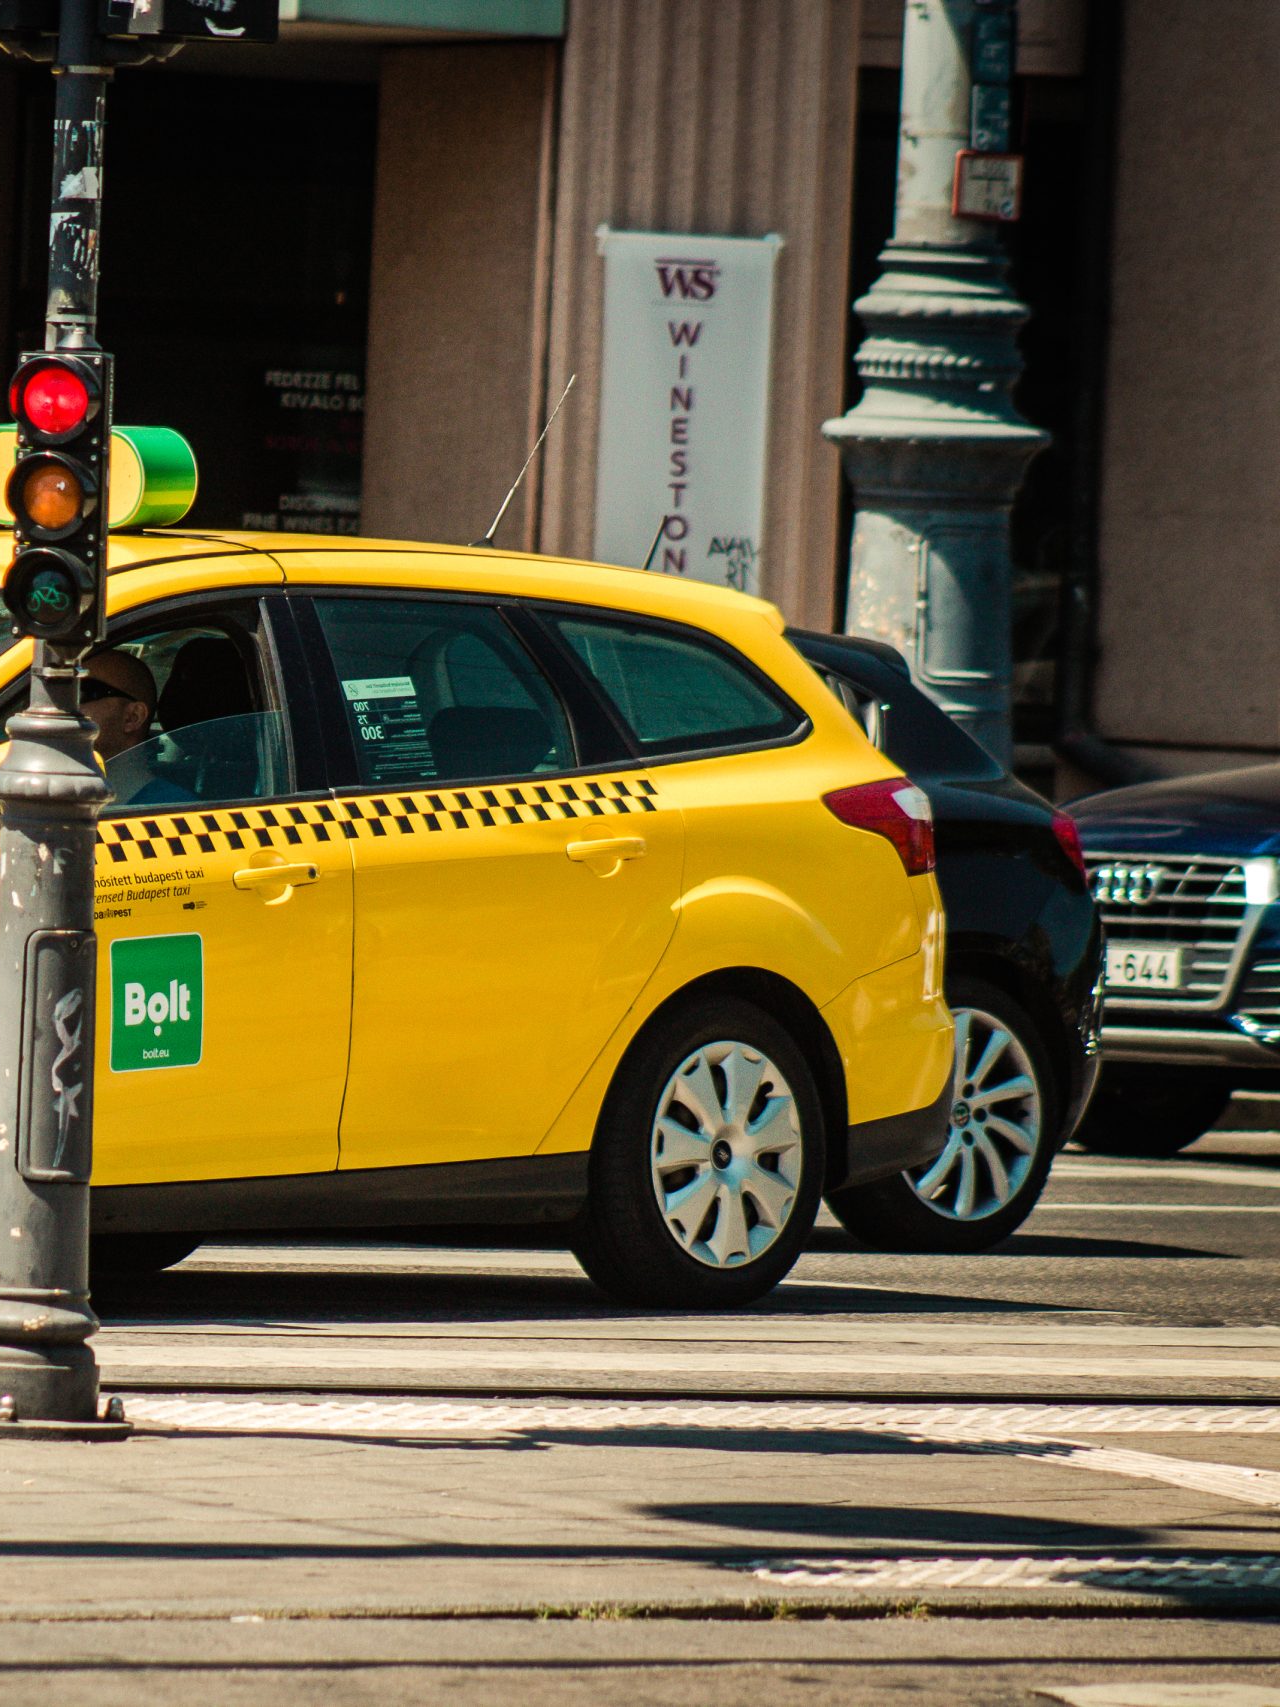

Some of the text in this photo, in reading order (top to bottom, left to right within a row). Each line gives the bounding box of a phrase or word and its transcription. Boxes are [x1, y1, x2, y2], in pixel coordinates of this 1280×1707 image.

[656, 267, 716, 301] WS
[133, 868, 184, 886] budapesti
[185, 866, 205, 880] taxi
[94, 884, 191, 905] ensed Budapest taxi
[1104, 953, 1169, 983] -644
[124, 978, 191, 1027] Bolt
[141, 1047, 171, 1061] bolt.eu
